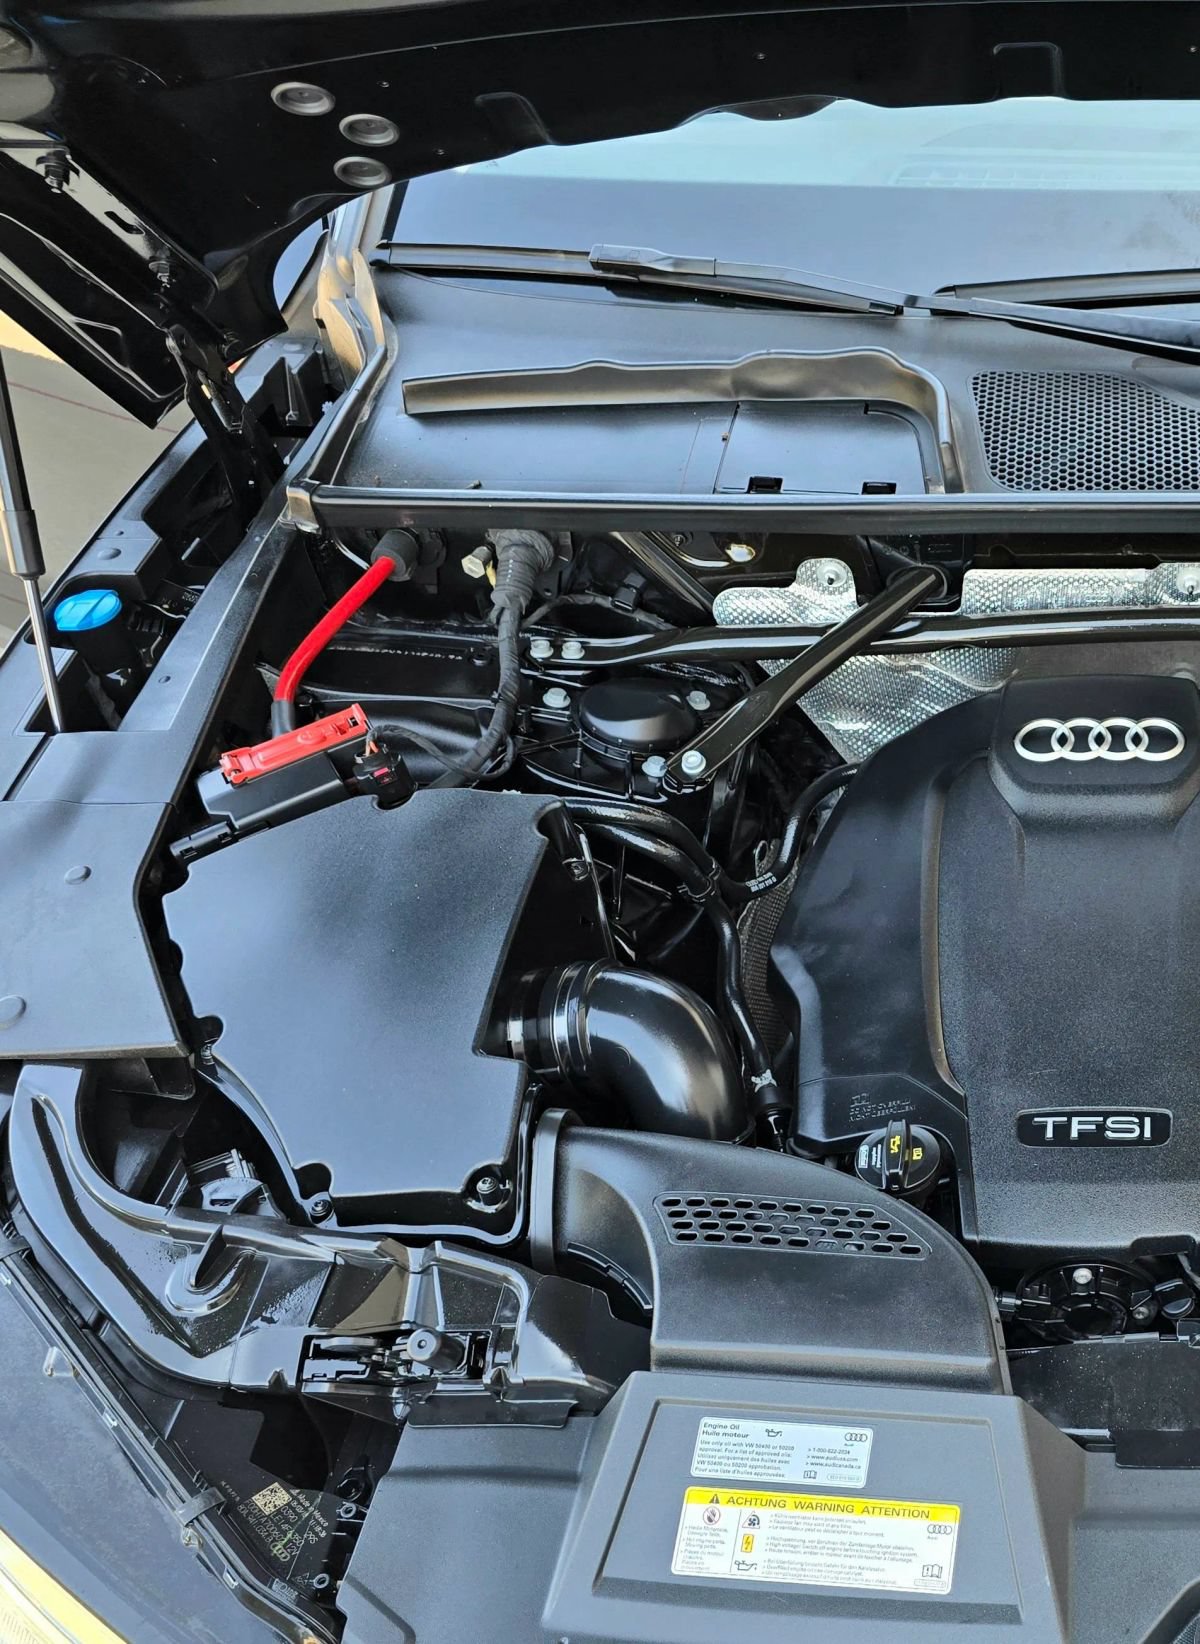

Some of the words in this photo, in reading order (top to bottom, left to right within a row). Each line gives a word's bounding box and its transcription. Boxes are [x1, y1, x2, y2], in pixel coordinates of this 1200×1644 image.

[1032, 1116, 1151, 1140] TFSI
[726, 1495, 787, 1509] ACHTUNG
[794, 1500, 854, 1514] WARNING
[860, 1505, 931, 1519] ATTENTION
